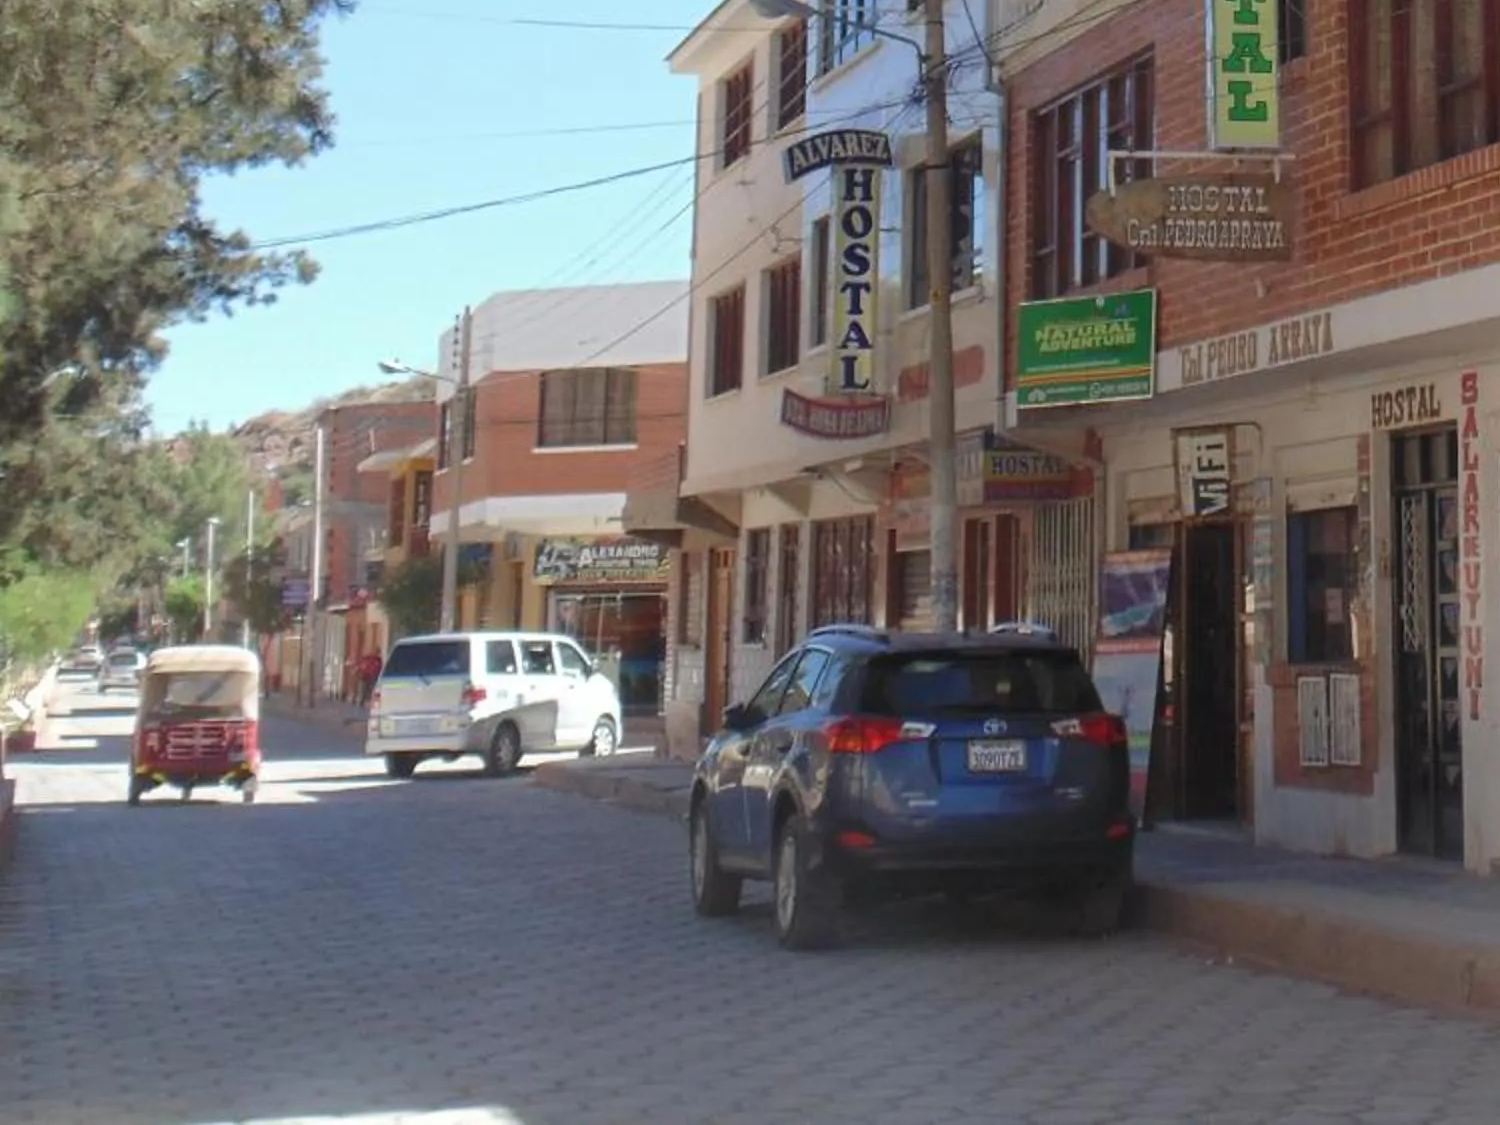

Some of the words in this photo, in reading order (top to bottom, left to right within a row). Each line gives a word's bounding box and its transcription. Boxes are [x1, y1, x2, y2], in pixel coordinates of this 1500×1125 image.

[792, 132, 888, 173] ALVAREZ
[1168, 186, 1269, 213] HOSTAL
[1164, 218, 1217, 248] PEDRO
[839, 168, 873, 390] HOSTAL
[1035, 321, 1134, 343] NATURAL
[1040, 329, 1136, 352] ADVENTURE
[1206, 331, 1258, 379] PEDRO
[1268, 312, 1334, 365] ARRAYA
[1371, 383, 1441, 428] HOSTAL
